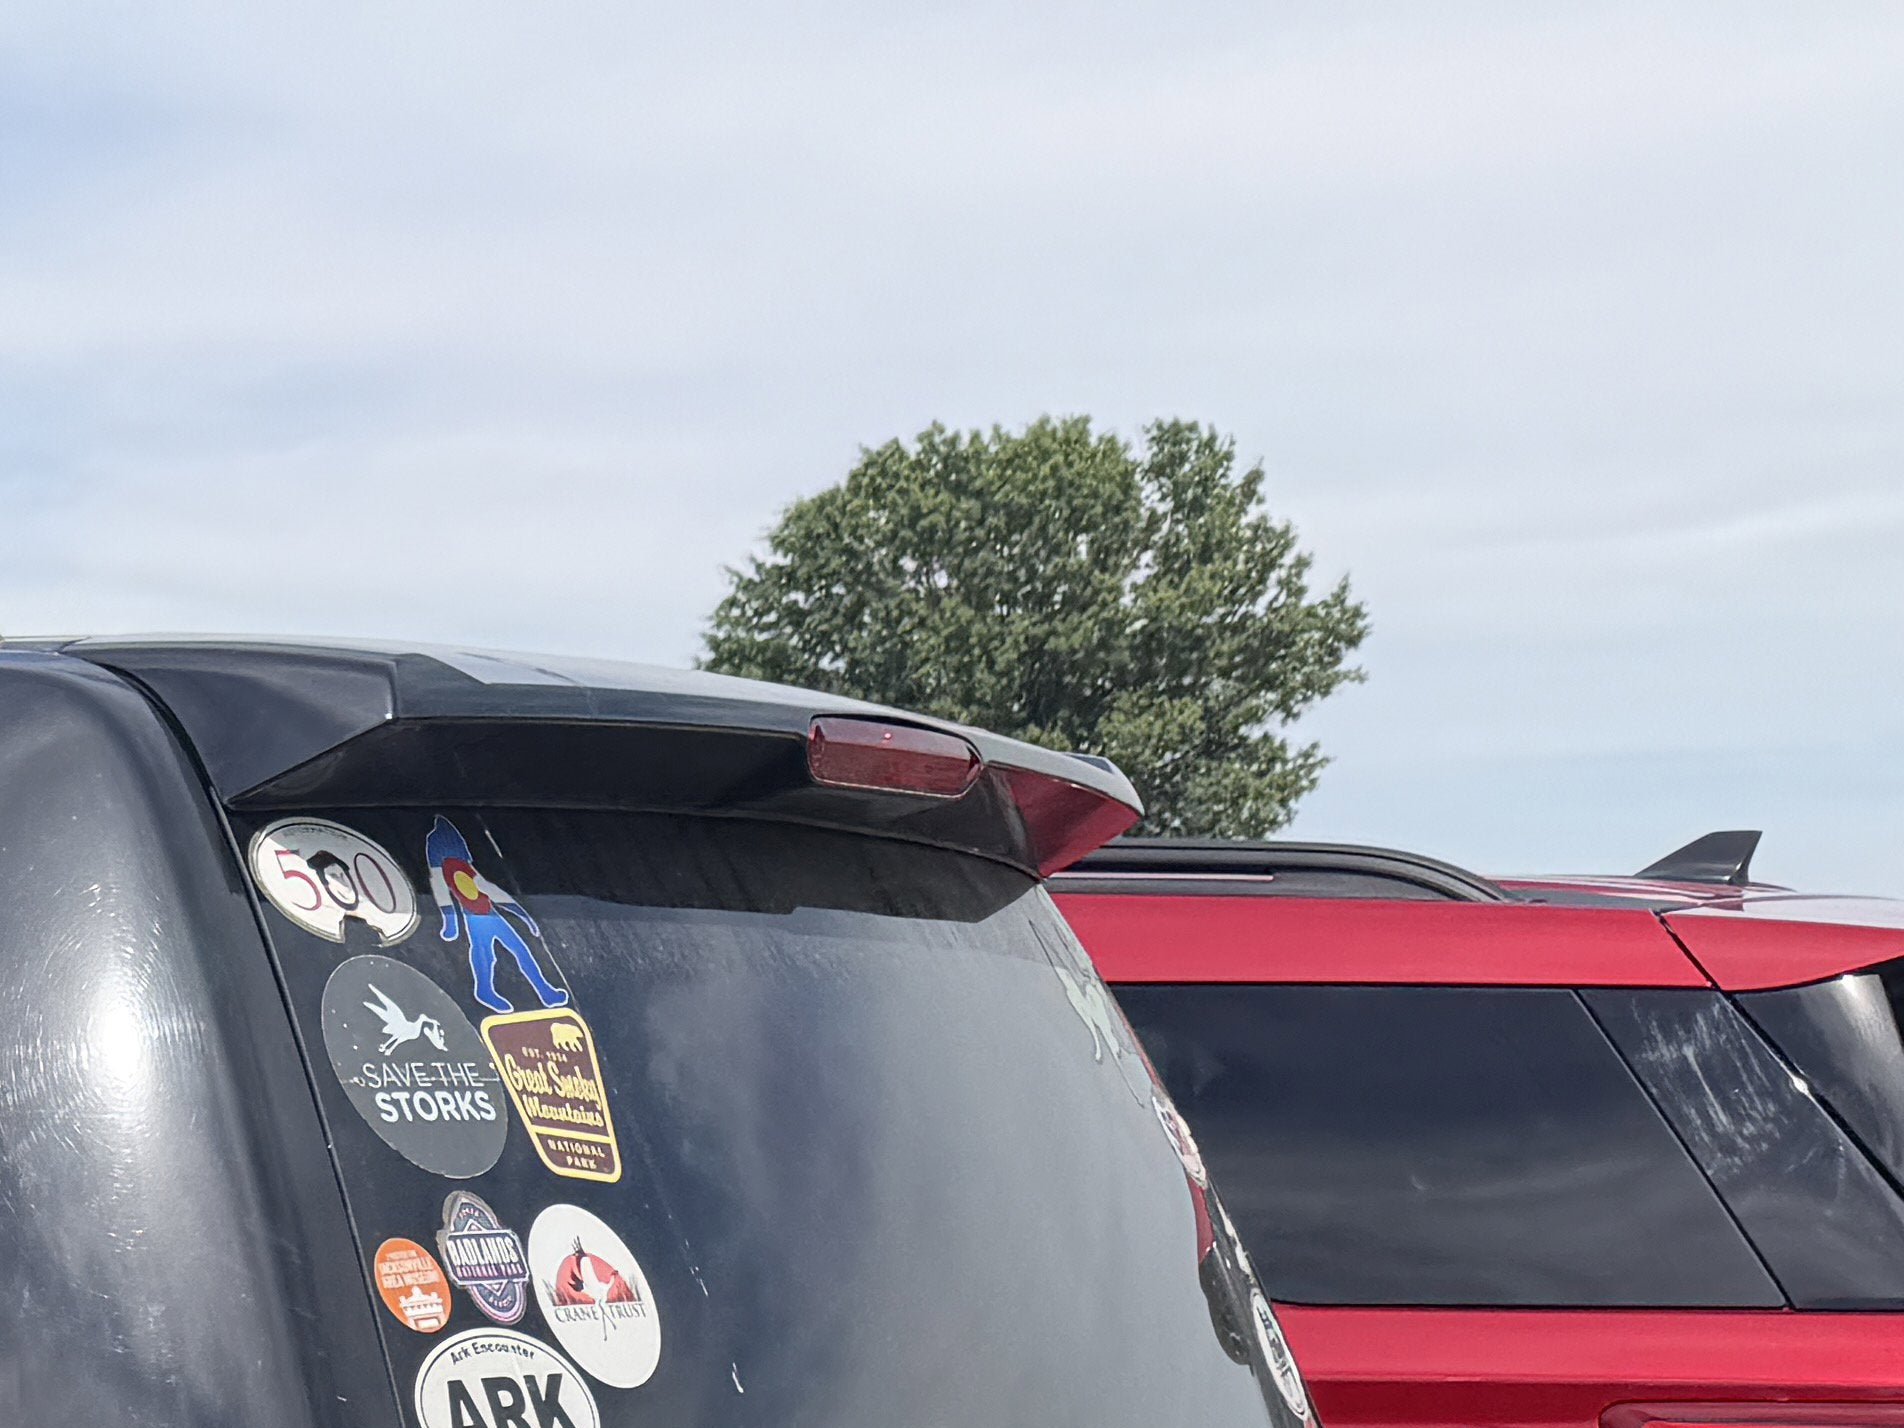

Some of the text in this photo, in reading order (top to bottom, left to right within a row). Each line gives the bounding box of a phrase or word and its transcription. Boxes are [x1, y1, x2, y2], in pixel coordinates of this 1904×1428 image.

[362, 1062, 485, 1089] SAVE THE
[504, 1053, 603, 1111] Great Smoky
[375, 1090, 497, 1122] STORKS
[522, 1094, 604, 1127] Mountains
[547, 1139, 606, 1158] NATIONAL
[566, 1155, 598, 1170] PARK
[447, 1236, 520, 1266] BADLANDS
[554, 1303, 647, 1323] CRANE TRUST
[450, 1341, 535, 1365] Ark Encounter
